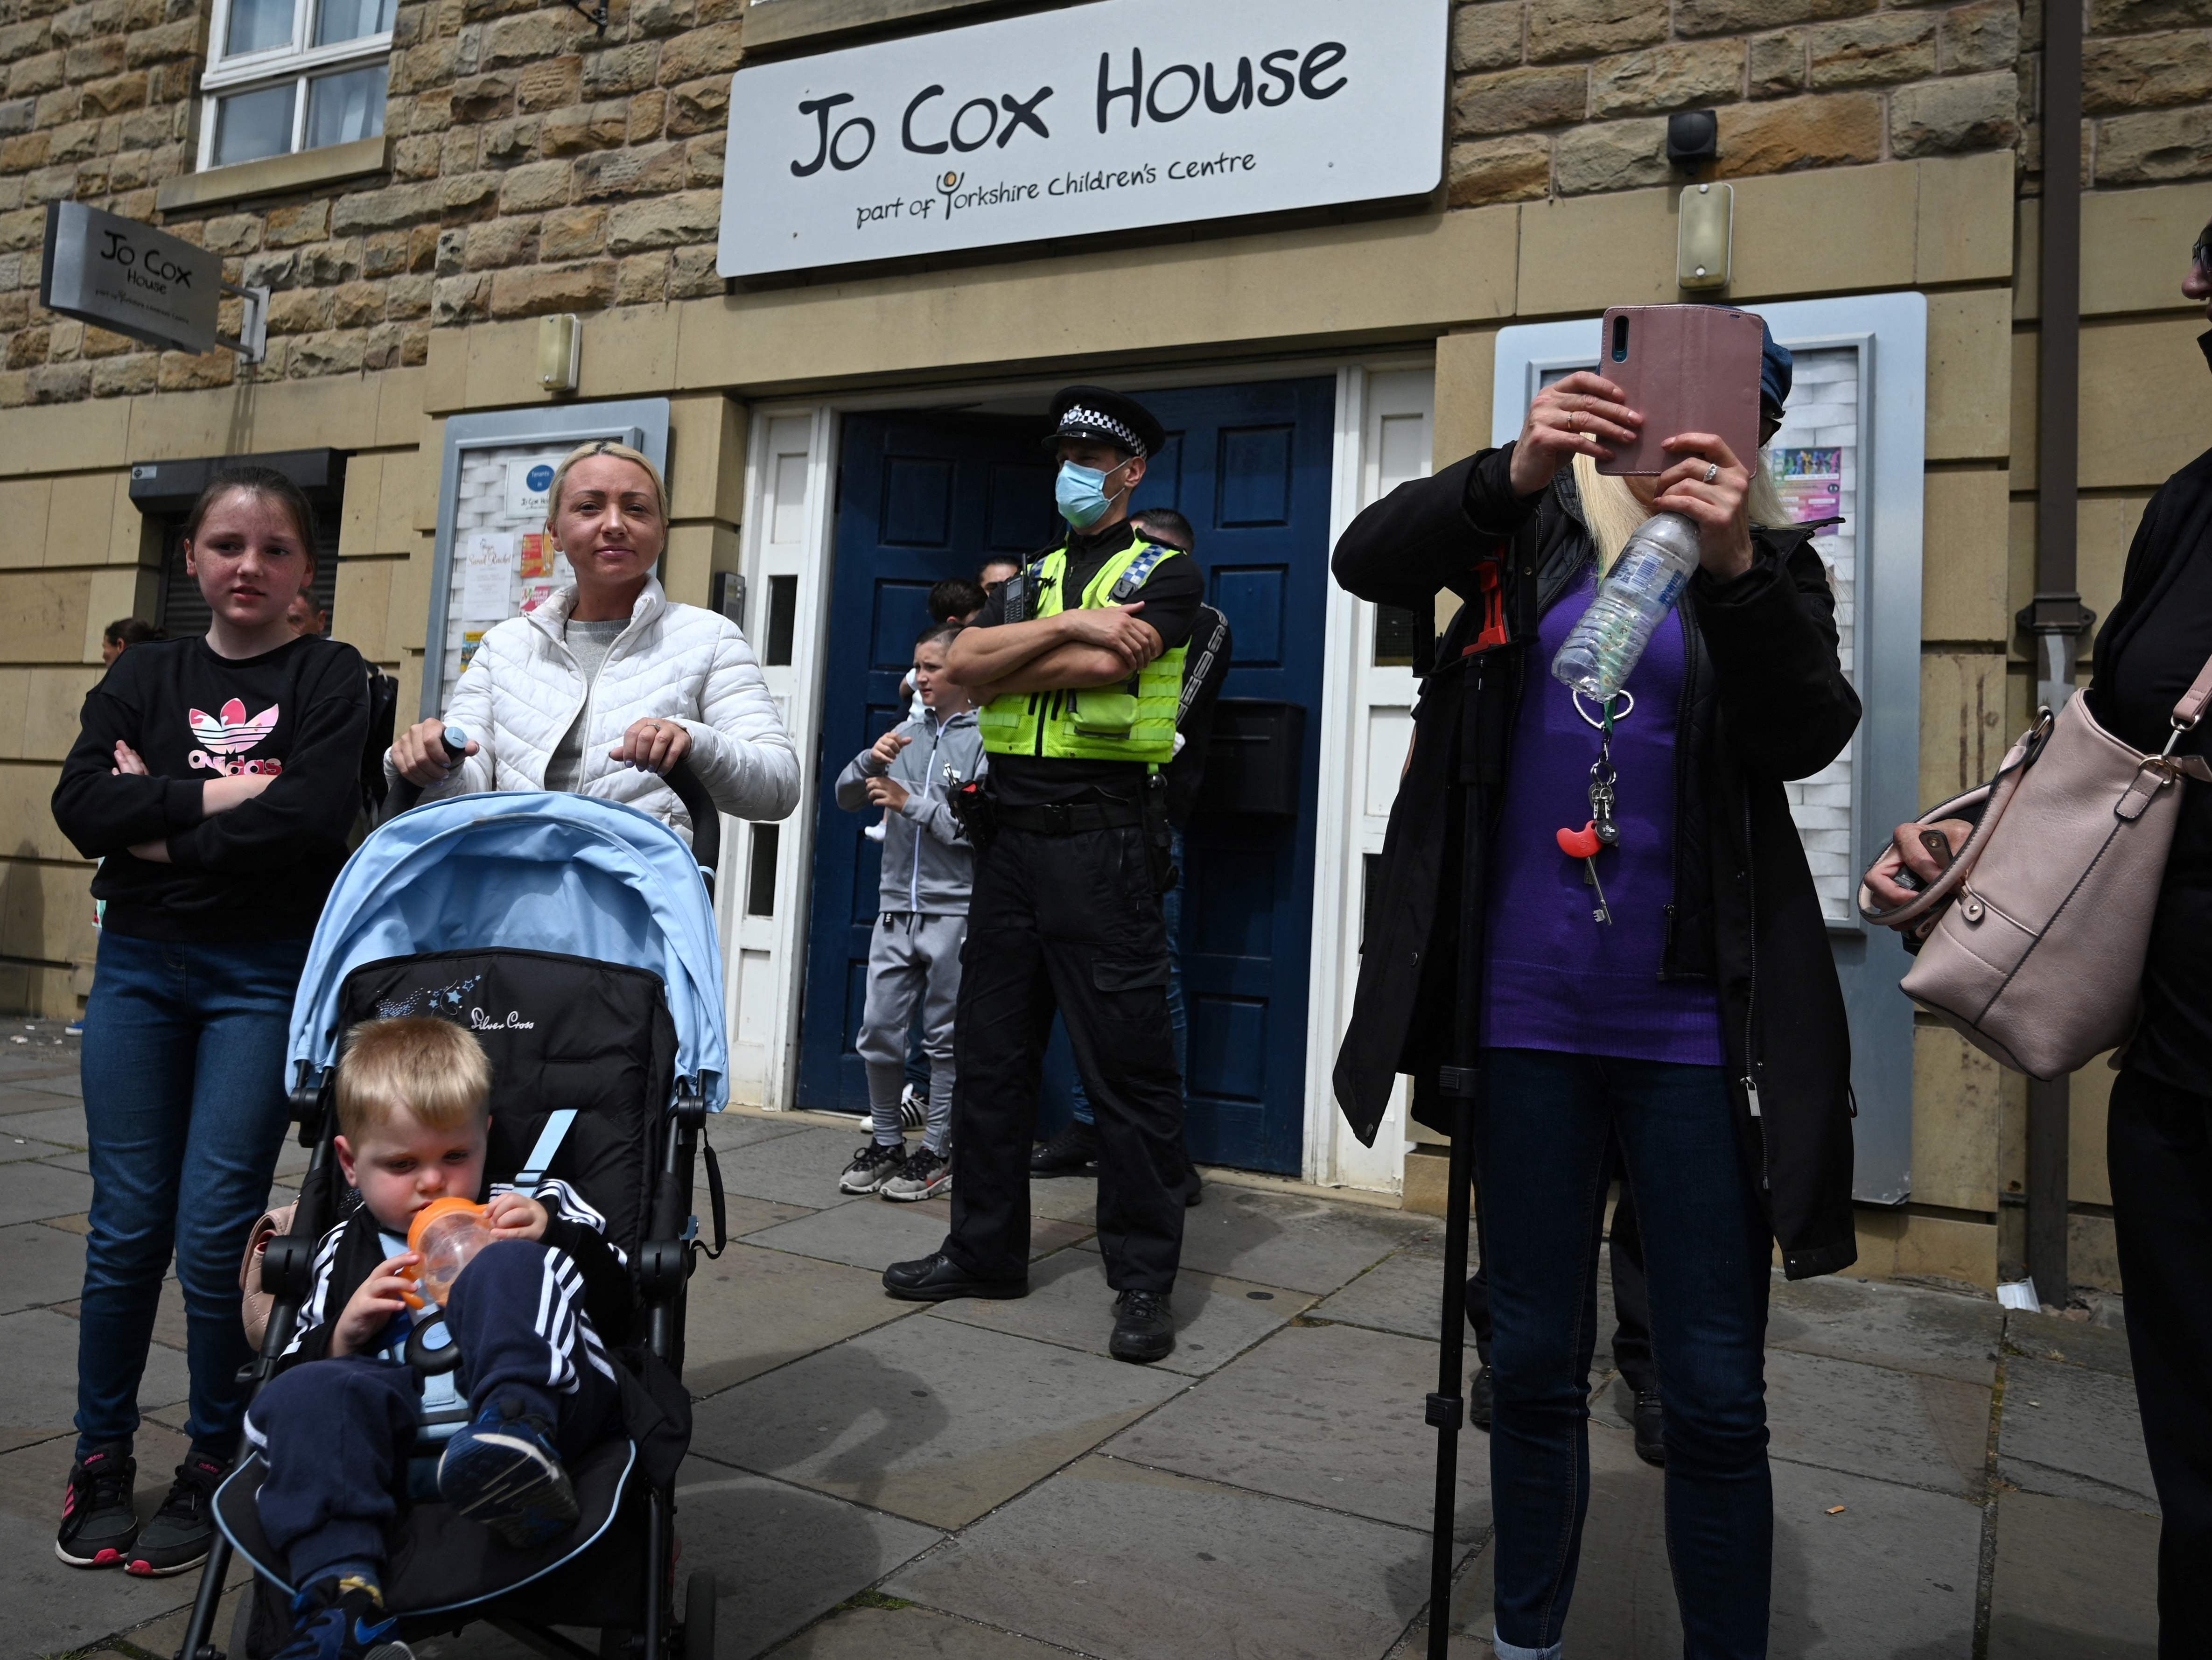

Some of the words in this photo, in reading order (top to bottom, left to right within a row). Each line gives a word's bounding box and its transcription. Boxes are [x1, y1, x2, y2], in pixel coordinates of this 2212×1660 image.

[790, 92, 876, 178] Jo
[901, 84, 1054, 155] Cox
[1096, 41, 1348, 134] House
[856, 196, 904, 230] part
[909, 198, 936, 219] of
[936, 171, 1040, 220] Yorkshire
[1048, 163, 1156, 196] Children's
[1168, 152, 1256, 180] Centre
[100, 229, 135, 266] Jo
[144, 248, 192, 289] Cox
[127, 268, 167, 295] House
[471, 1007, 505, 1030] Silver
[506, 1010, 535, 1030] Cross
[84, 1453, 104, 1465] adidas
